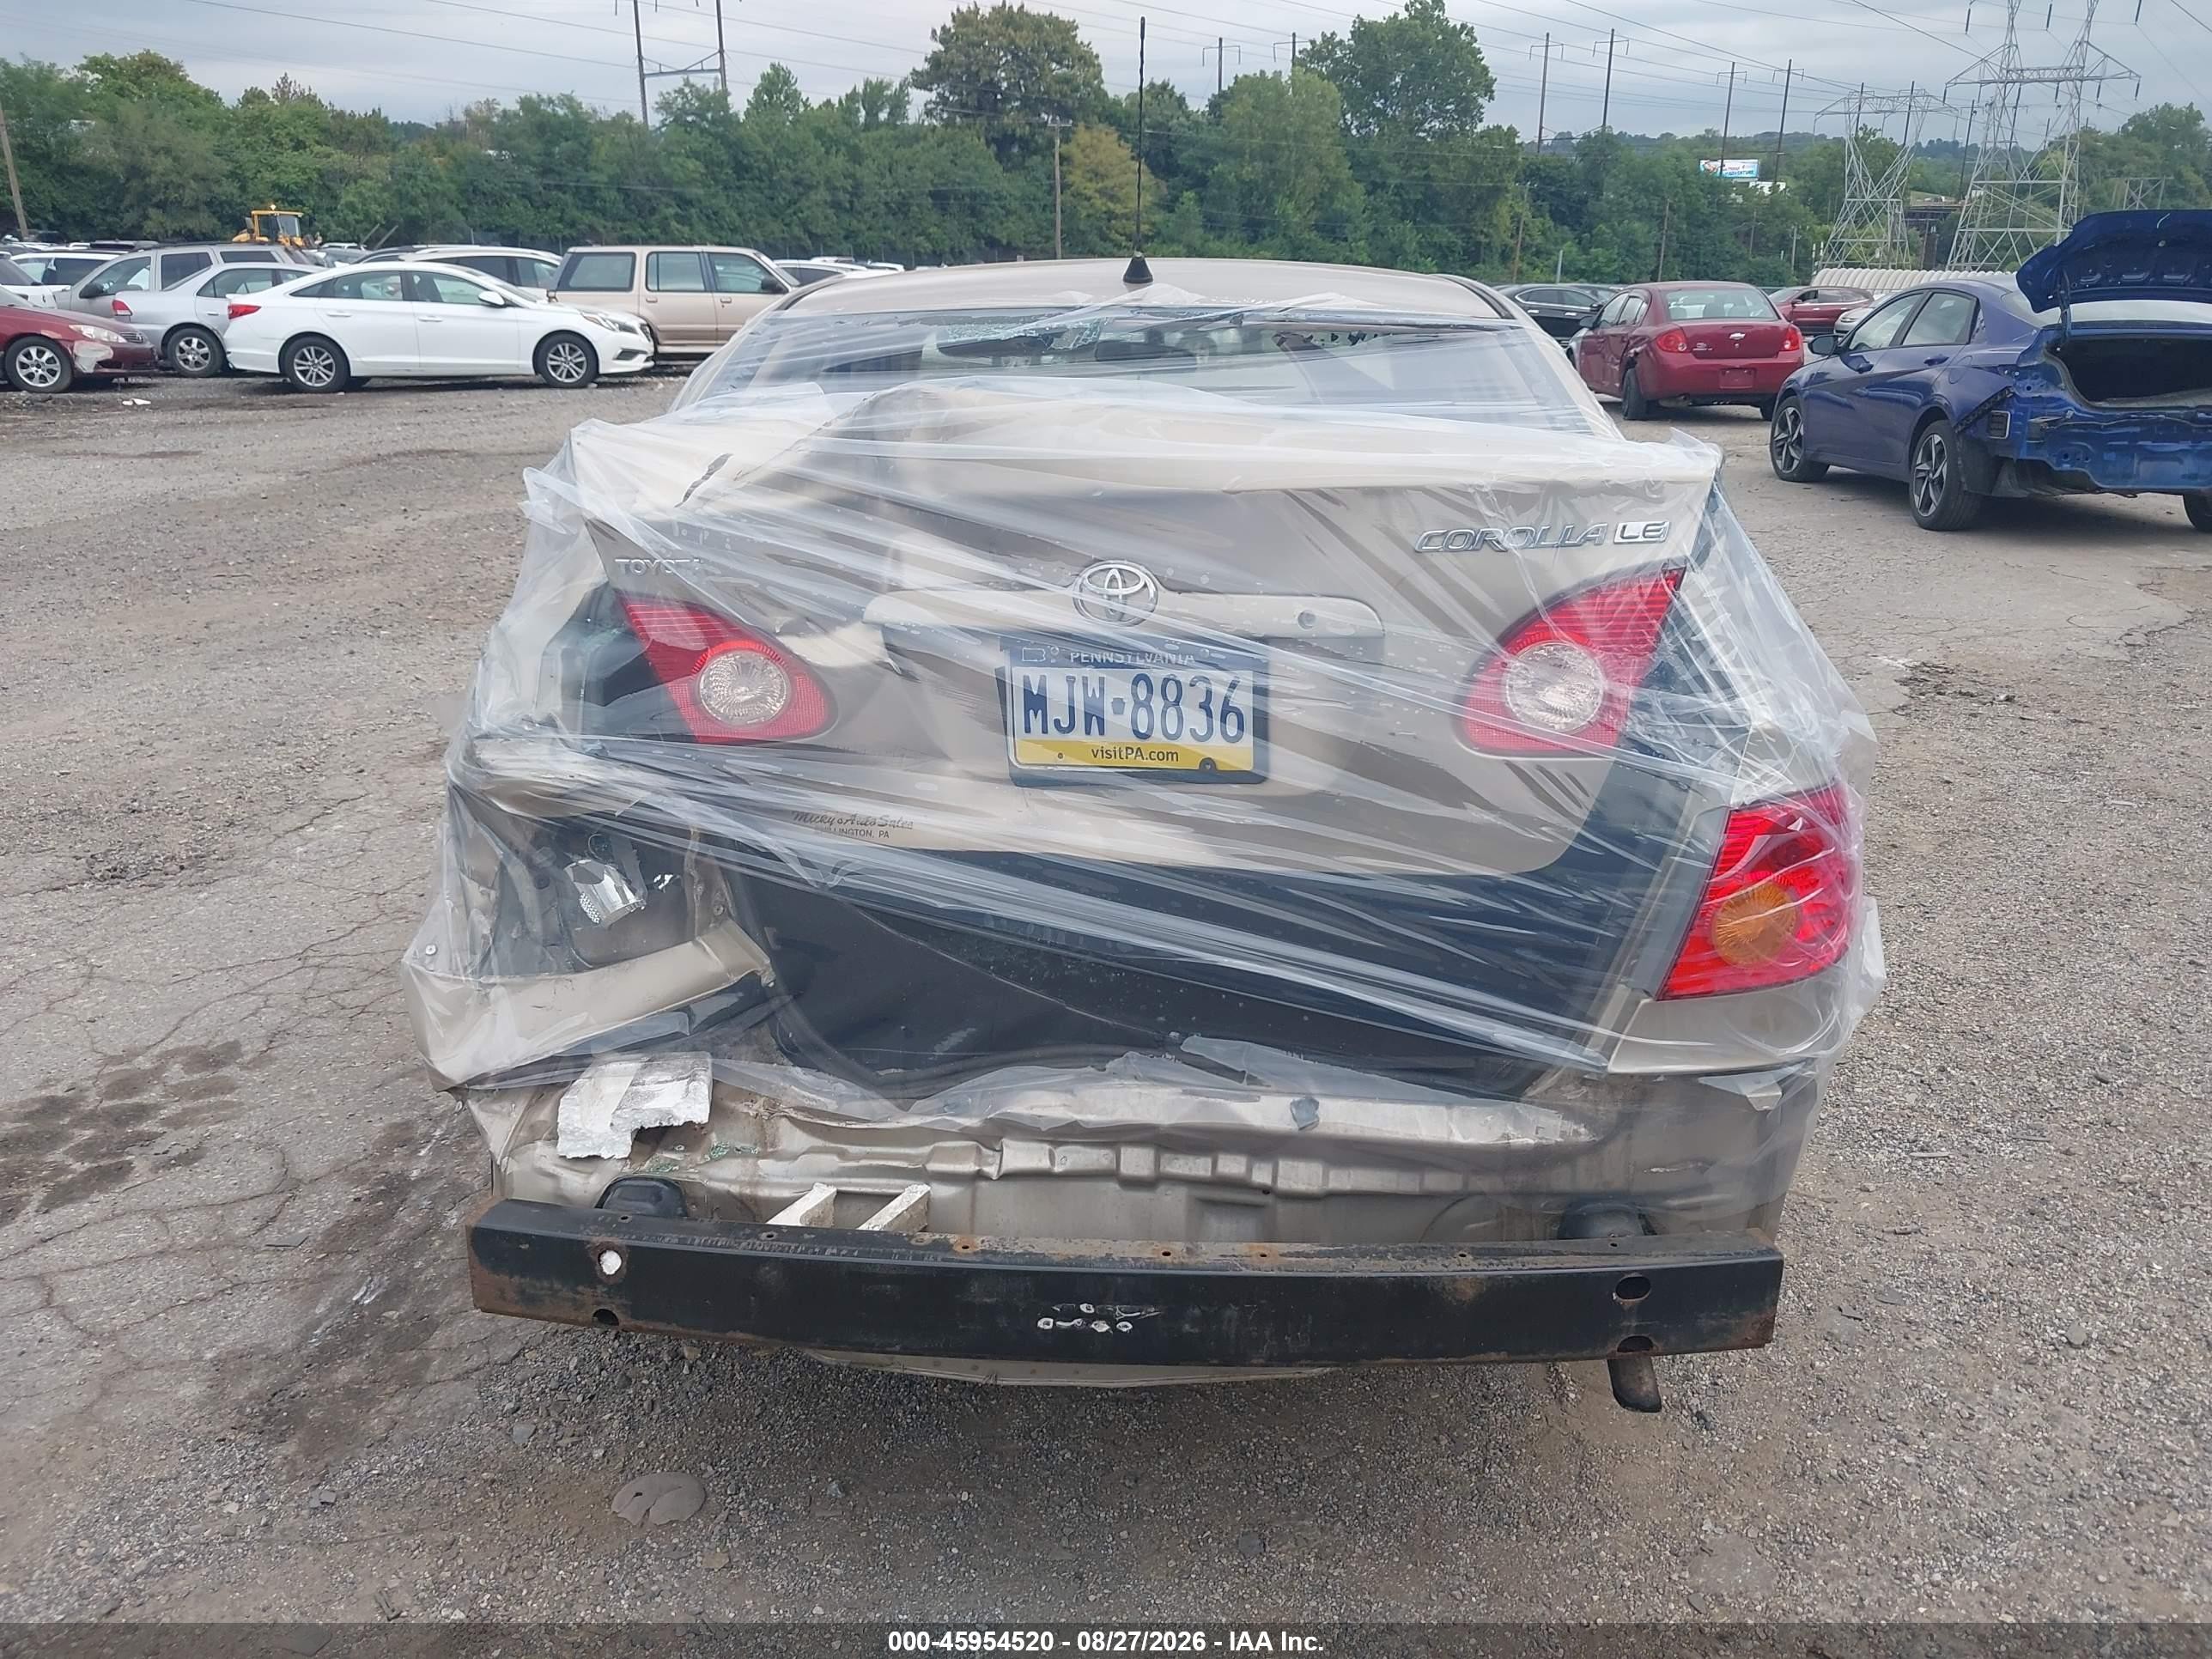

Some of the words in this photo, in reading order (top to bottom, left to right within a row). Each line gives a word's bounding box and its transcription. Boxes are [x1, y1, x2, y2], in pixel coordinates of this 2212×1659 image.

[1415, 523, 1608, 553] COROLLA
[1619, 521, 1669, 543] LE
[1091, 746, 1179, 763] visitPA.com
[843, 813, 877, 827] Auto
[878, 815, 914, 830] Sales
[878, 830, 890, 839] PA
